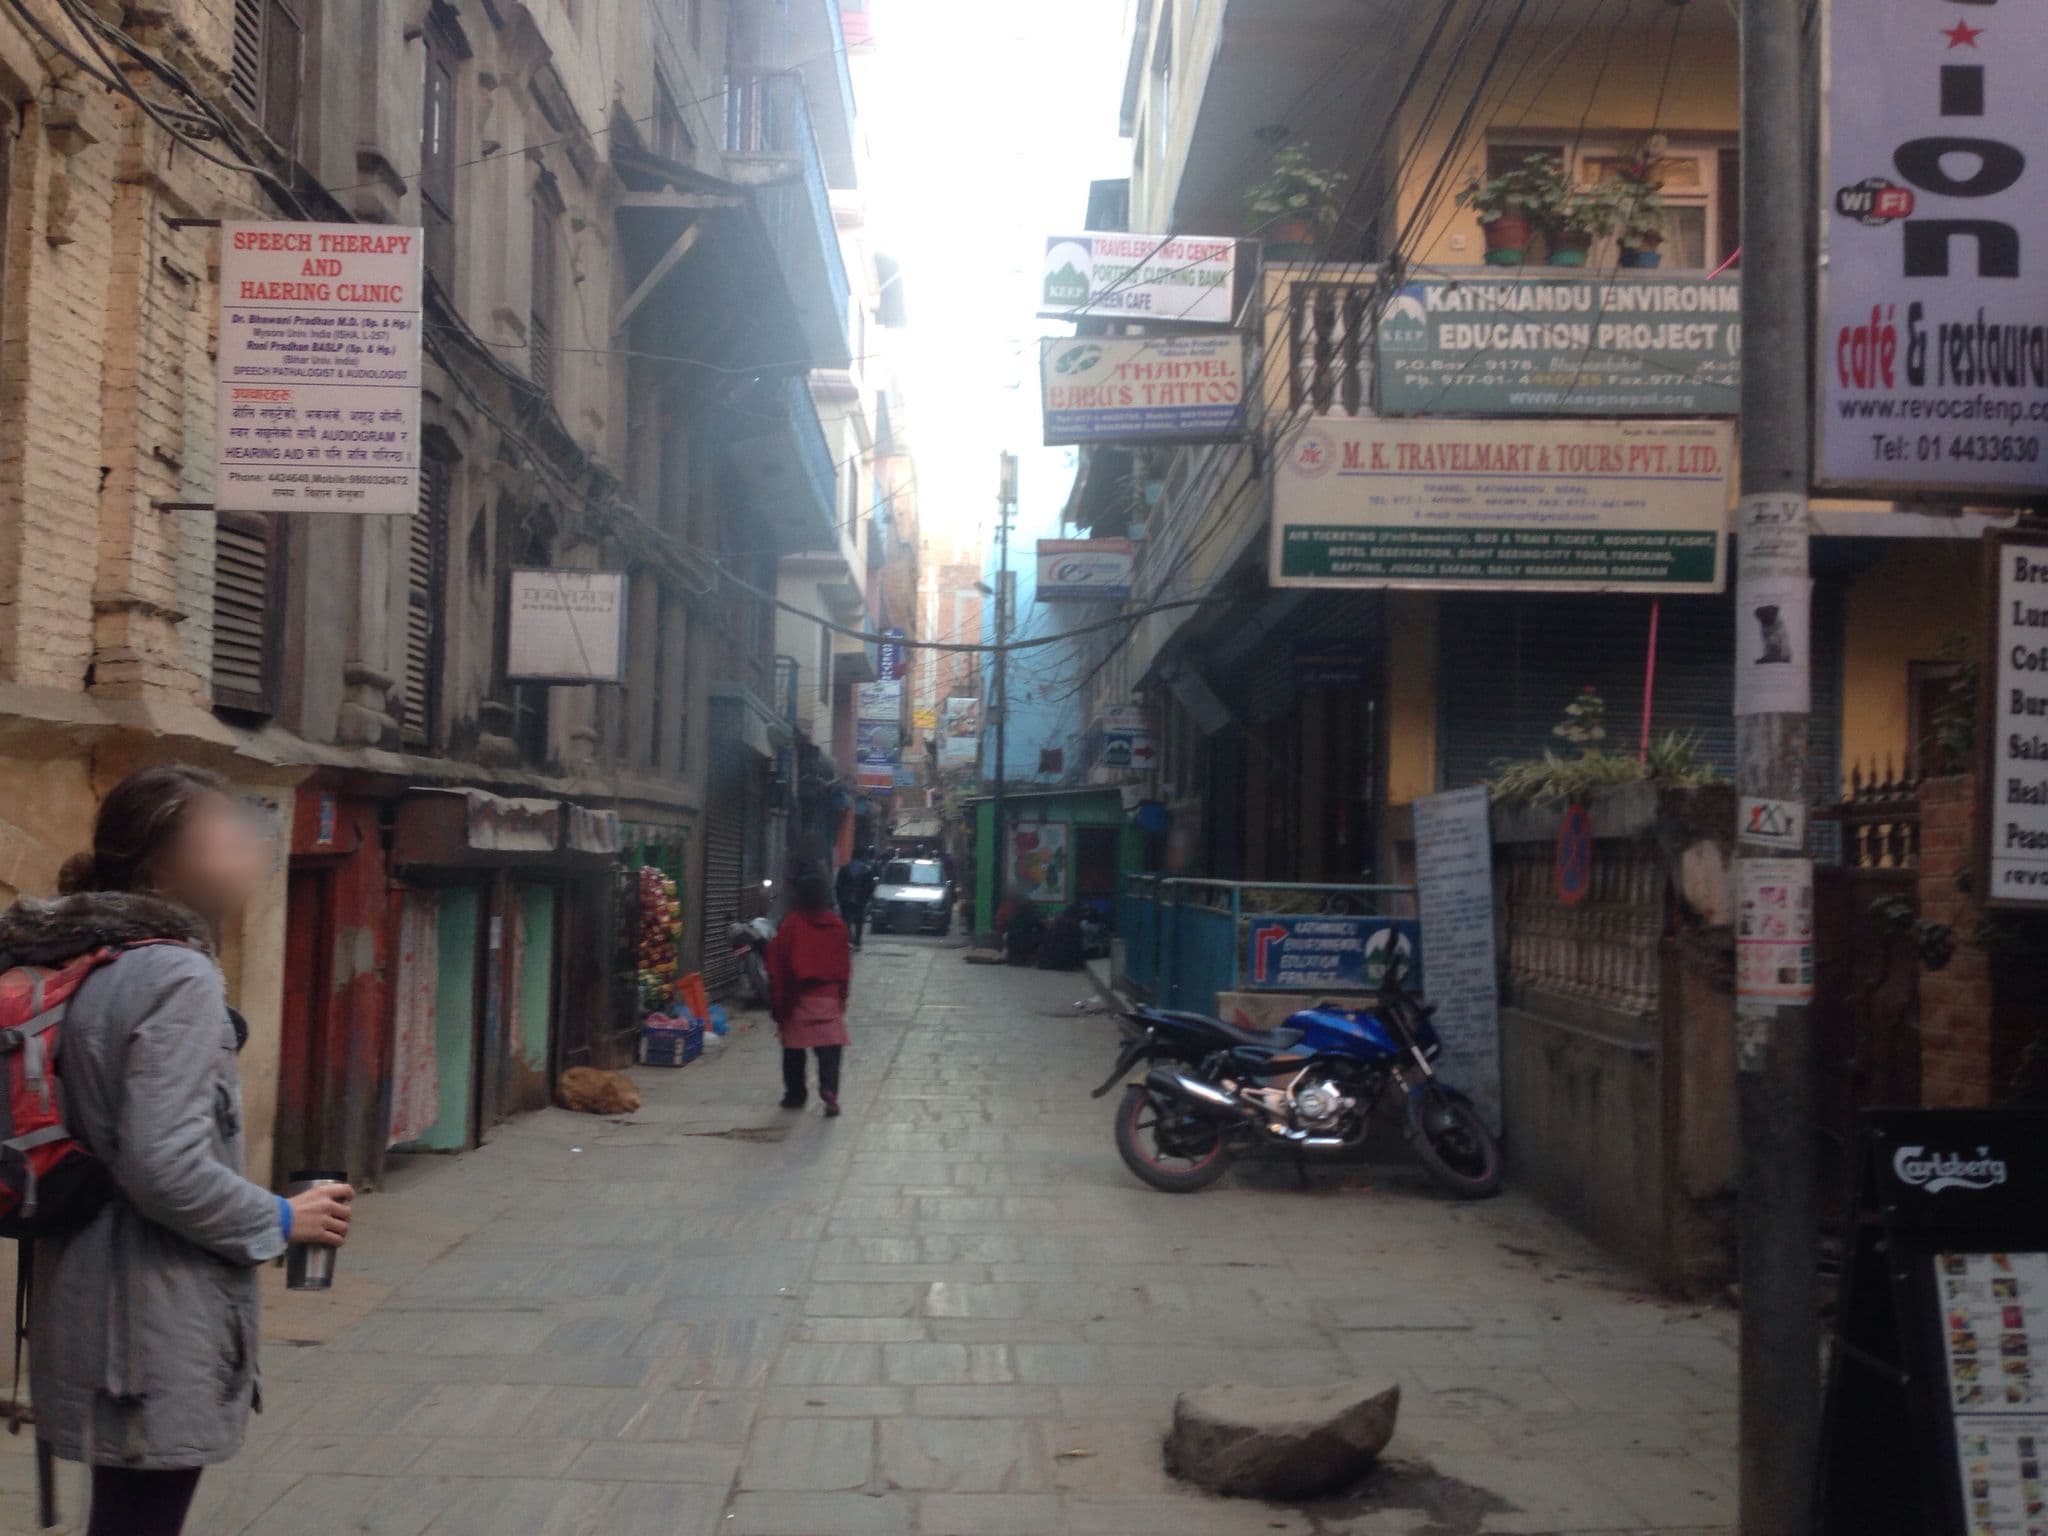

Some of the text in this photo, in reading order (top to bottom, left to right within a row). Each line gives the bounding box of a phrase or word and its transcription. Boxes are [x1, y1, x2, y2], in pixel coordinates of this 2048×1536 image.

[1893, 0, 2026, 278] ion
[234, 232, 411, 254] SPEECH THERAPY
[1188, 241, 1229, 262] CENTER
[301, 258, 342, 277] AND
[239, 281, 402, 303] HAERING CLINIC
[1127, 293, 1152, 310] CAFE
[1426, 286, 1592, 312] KATHMANDU
[232, 313, 246, 324] Dr.
[1439, 323, 1590, 350] EDUCATION
[1600, 324, 1717, 350] PROJECT
[1838, 301, 2048, 389] café & restaura
[1116, 359, 1236, 380] THAMEL
[1141, 381, 1239, 405] TATTOO
[320, 430, 396, 442] AUDIOGRAM
[224, 447, 281, 459] HEARING
[283, 448, 304, 459] AID
[1342, 441, 1722, 474] M. K. TRAVELMART & TOURS PVT. LTD.
[1872, 434, 2039, 463] Tel: 01 4433630
[1312, 532, 1377, 542] TICKETING
[1474, 533, 1499, 543] BUS
[1514, 534, 1550, 544] TRAIN
[1602, 536, 1666, 545] MOUNTAIN
[1328, 547, 1366, 557] HOTEL
[1893, 1146, 2007, 1184] Carlsberg
